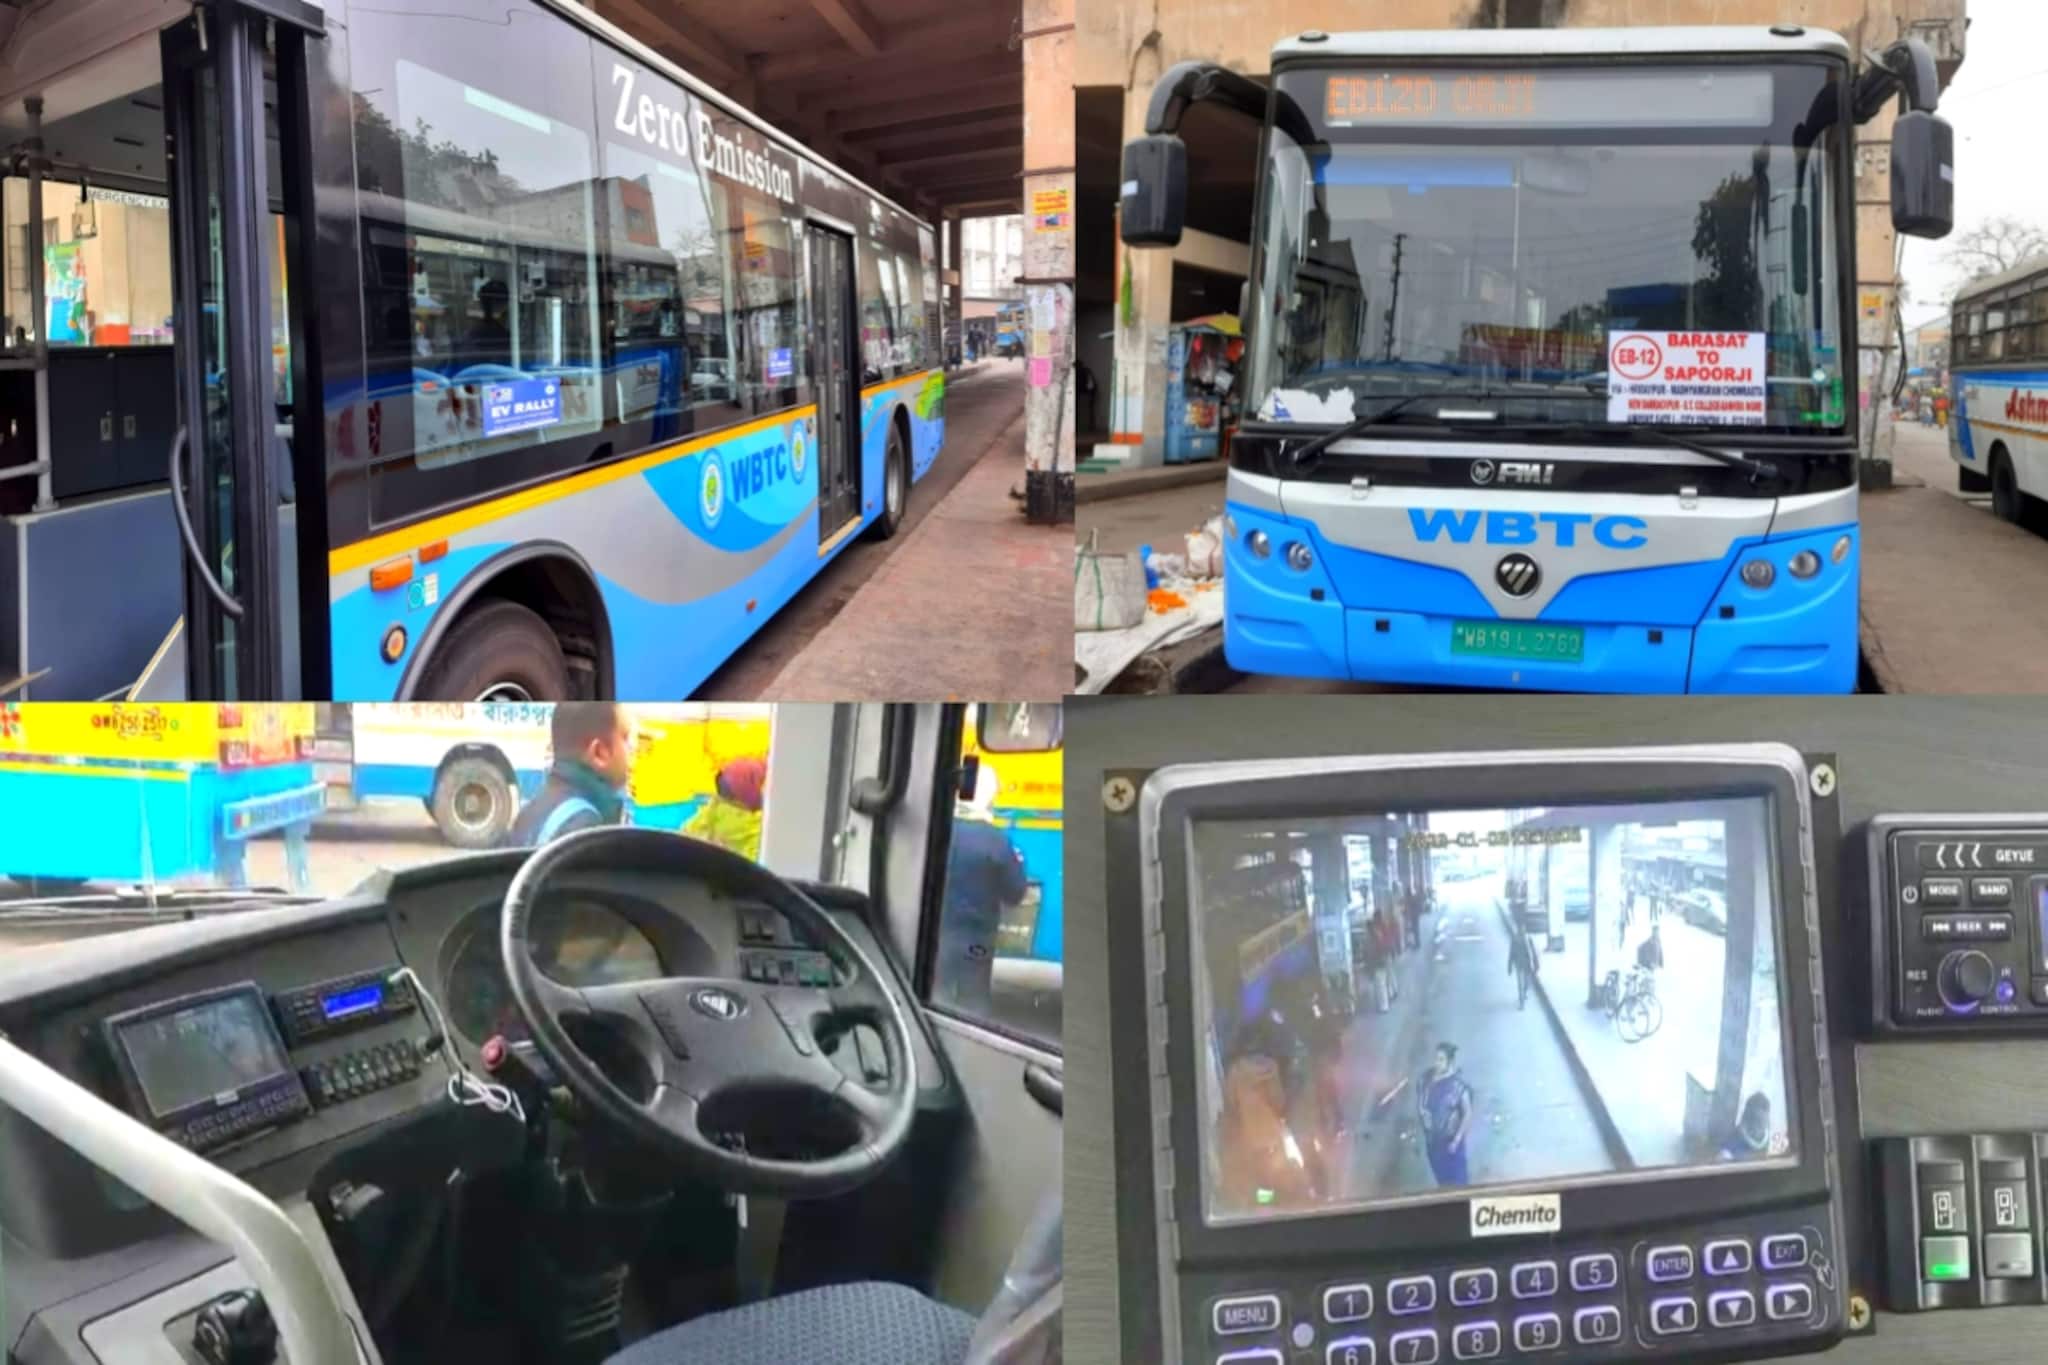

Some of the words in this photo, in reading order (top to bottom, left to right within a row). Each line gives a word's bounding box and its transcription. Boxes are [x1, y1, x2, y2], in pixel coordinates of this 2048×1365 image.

[612, 63, 688, 156] Zero
[695, 109, 795, 204] Emission
[1667, 333, 1749, 348] BARASAT
[1618, 348, 1656, 366] EB-12
[1696, 350, 1720, 364] TO
[1664, 367, 1752, 382] SAPOORJI
[491, 405, 511, 418] EV
[513, 397, 556, 414] RALLY
[730, 443, 787, 503] WBTC
[1407, 507, 1648, 550] WBTC
[1995, 849, 2034, 863] GEYUE
[1928, 885, 1958, 896] MODE
[1979, 885, 2008, 896] BAND
[1956, 922, 1982, 932] SEEK
[1474, 1205, 1556, 1228] Chemito
[1775, 1244, 1797, 1259] EXIT
[1654, 1257, 1689, 1272] ENTER
[1344, 1294, 1355, 1315] 1
[1405, 1287, 1419, 1306] 2
[1467, 1278, 1482, 1298] 3
[1530, 1270, 1544, 1290] 4
[1588, 1263, 1601, 1284] 5
[1225, 1307, 1268, 1325] MENU
[1409, 1341, 1420, 1360] 7
[1471, 1333, 1484, 1352] 8
[1532, 1324, 1545, 1344] 9
[1593, 1317, 1606, 1336] 0
